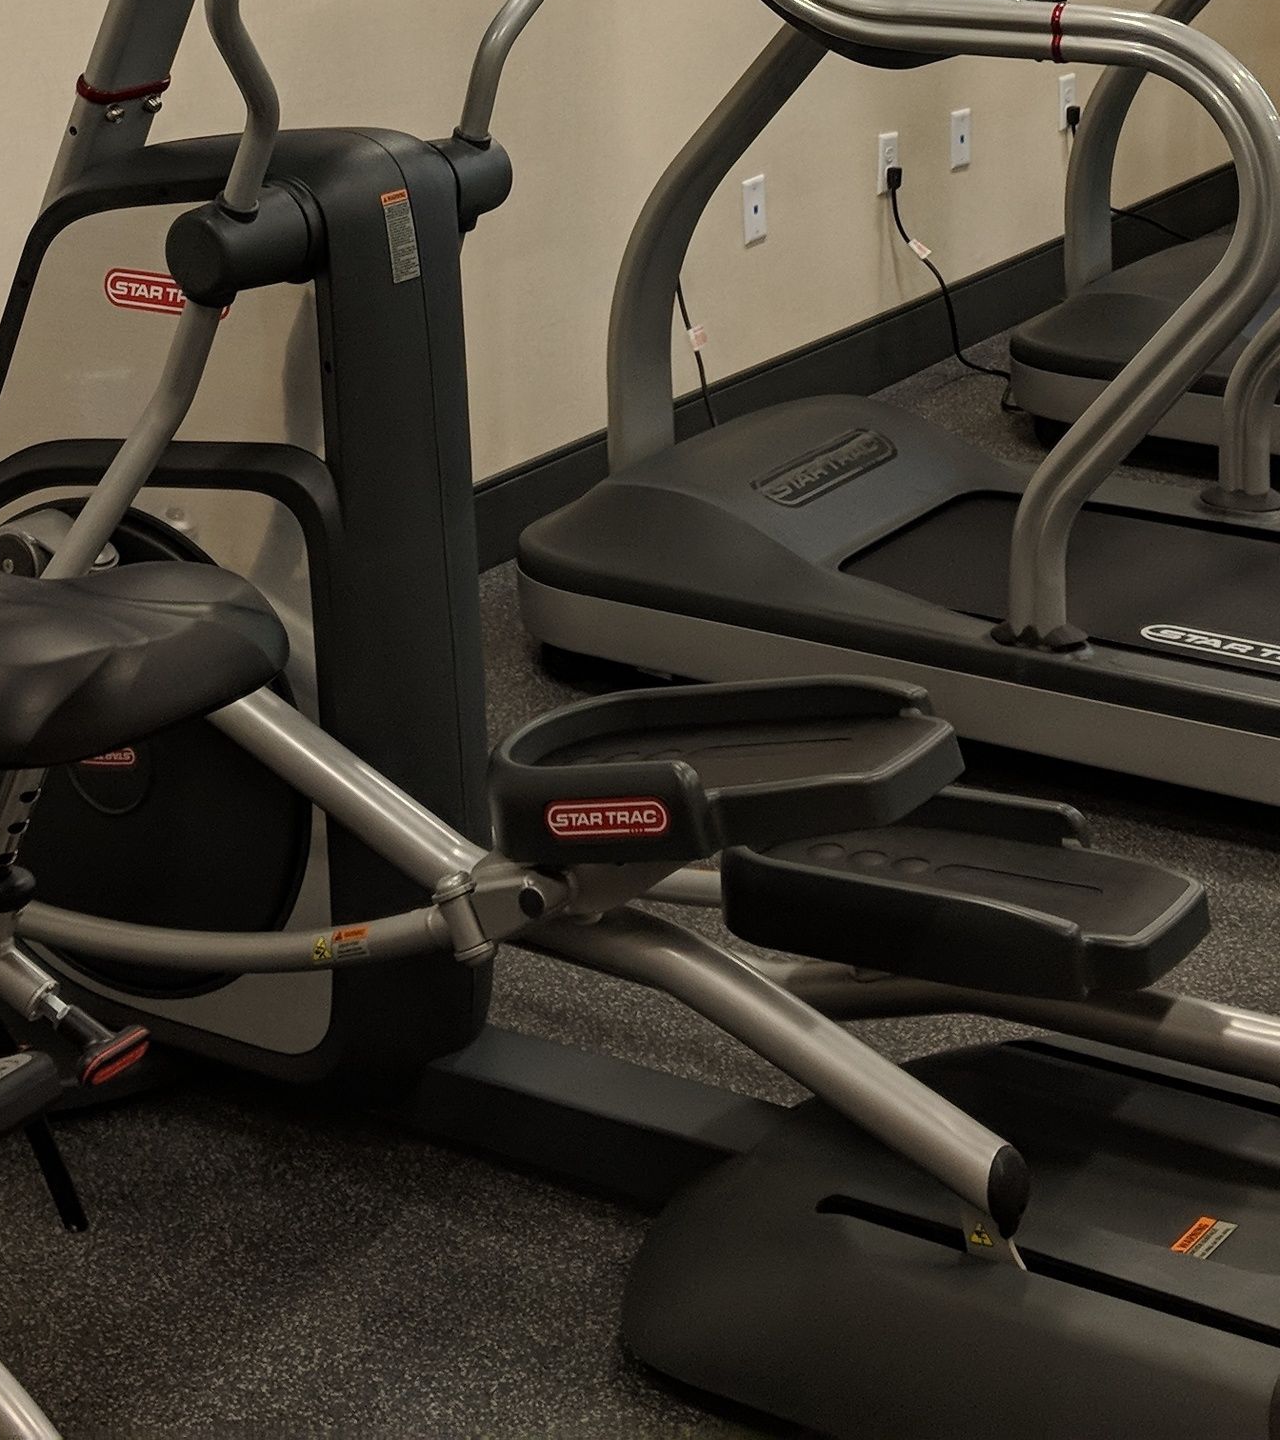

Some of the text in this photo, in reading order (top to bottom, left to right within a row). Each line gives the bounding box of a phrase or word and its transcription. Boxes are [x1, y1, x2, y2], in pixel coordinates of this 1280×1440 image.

[113, 280, 164, 300] STAR
[1157, 628, 1255, 654] STAR
[554, 809, 657, 827] STAR TRAC
[1176, 1222, 1210, 1249] WARNING
